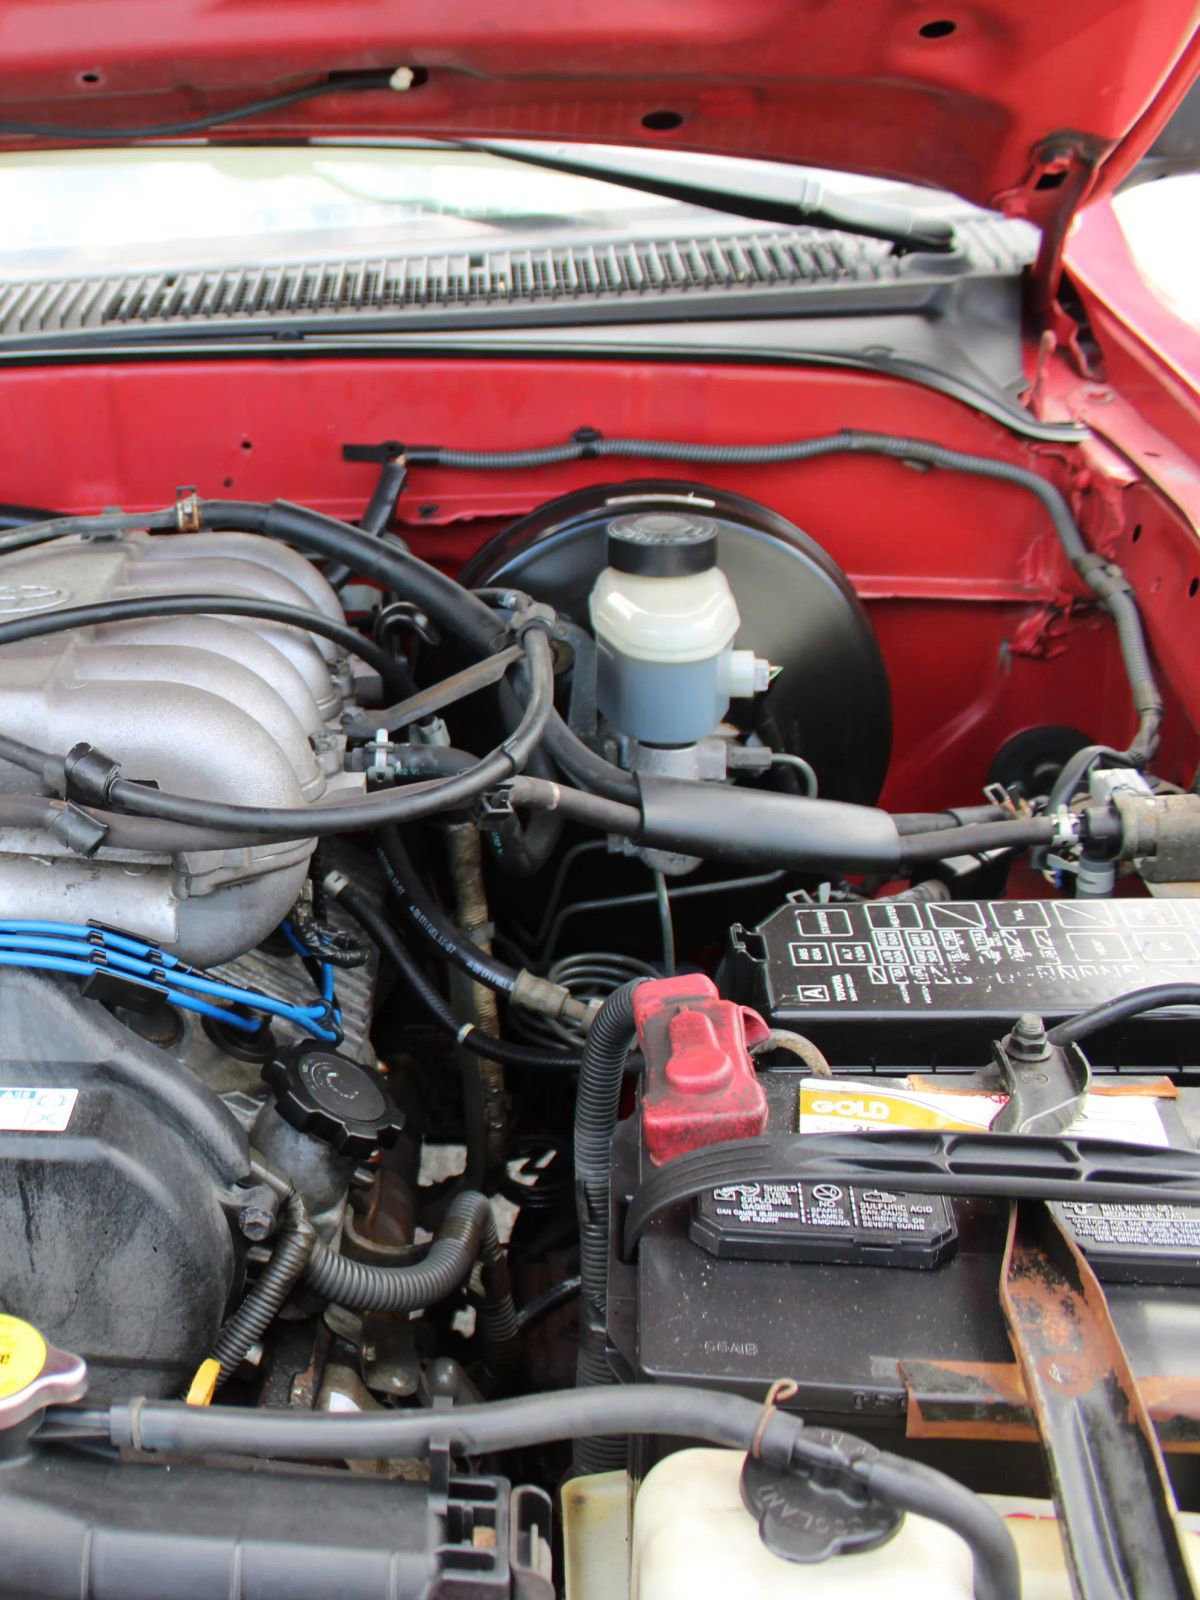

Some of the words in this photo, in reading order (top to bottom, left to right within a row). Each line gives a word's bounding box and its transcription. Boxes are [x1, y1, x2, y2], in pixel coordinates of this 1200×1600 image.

[832, 974, 847, 1001] TOYOTA
[803, 988, 825, 999] A
[810, 1099, 890, 1121] GOLD
[763, 1184, 798, 1193] SHIELD
[740, 1196, 792, 1206] EXPLOSIVE
[818, 1200, 835, 1208] NO
[741, 1203, 773, 1211] GASES
[860, 1202, 907, 1211] SULFURIC
[910, 1205, 933, 1213] ACID
[733, 1209, 757, 1217] CAUSE
[758, 1210, 799, 1219] BLINDNESS
[862, 1215, 908, 1223] BLINDNESS
[812, 1218, 851, 1226] SMOKING
[862, 1220, 894, 1228] SEVERE
[897, 1222, 925, 1230] BURNS
